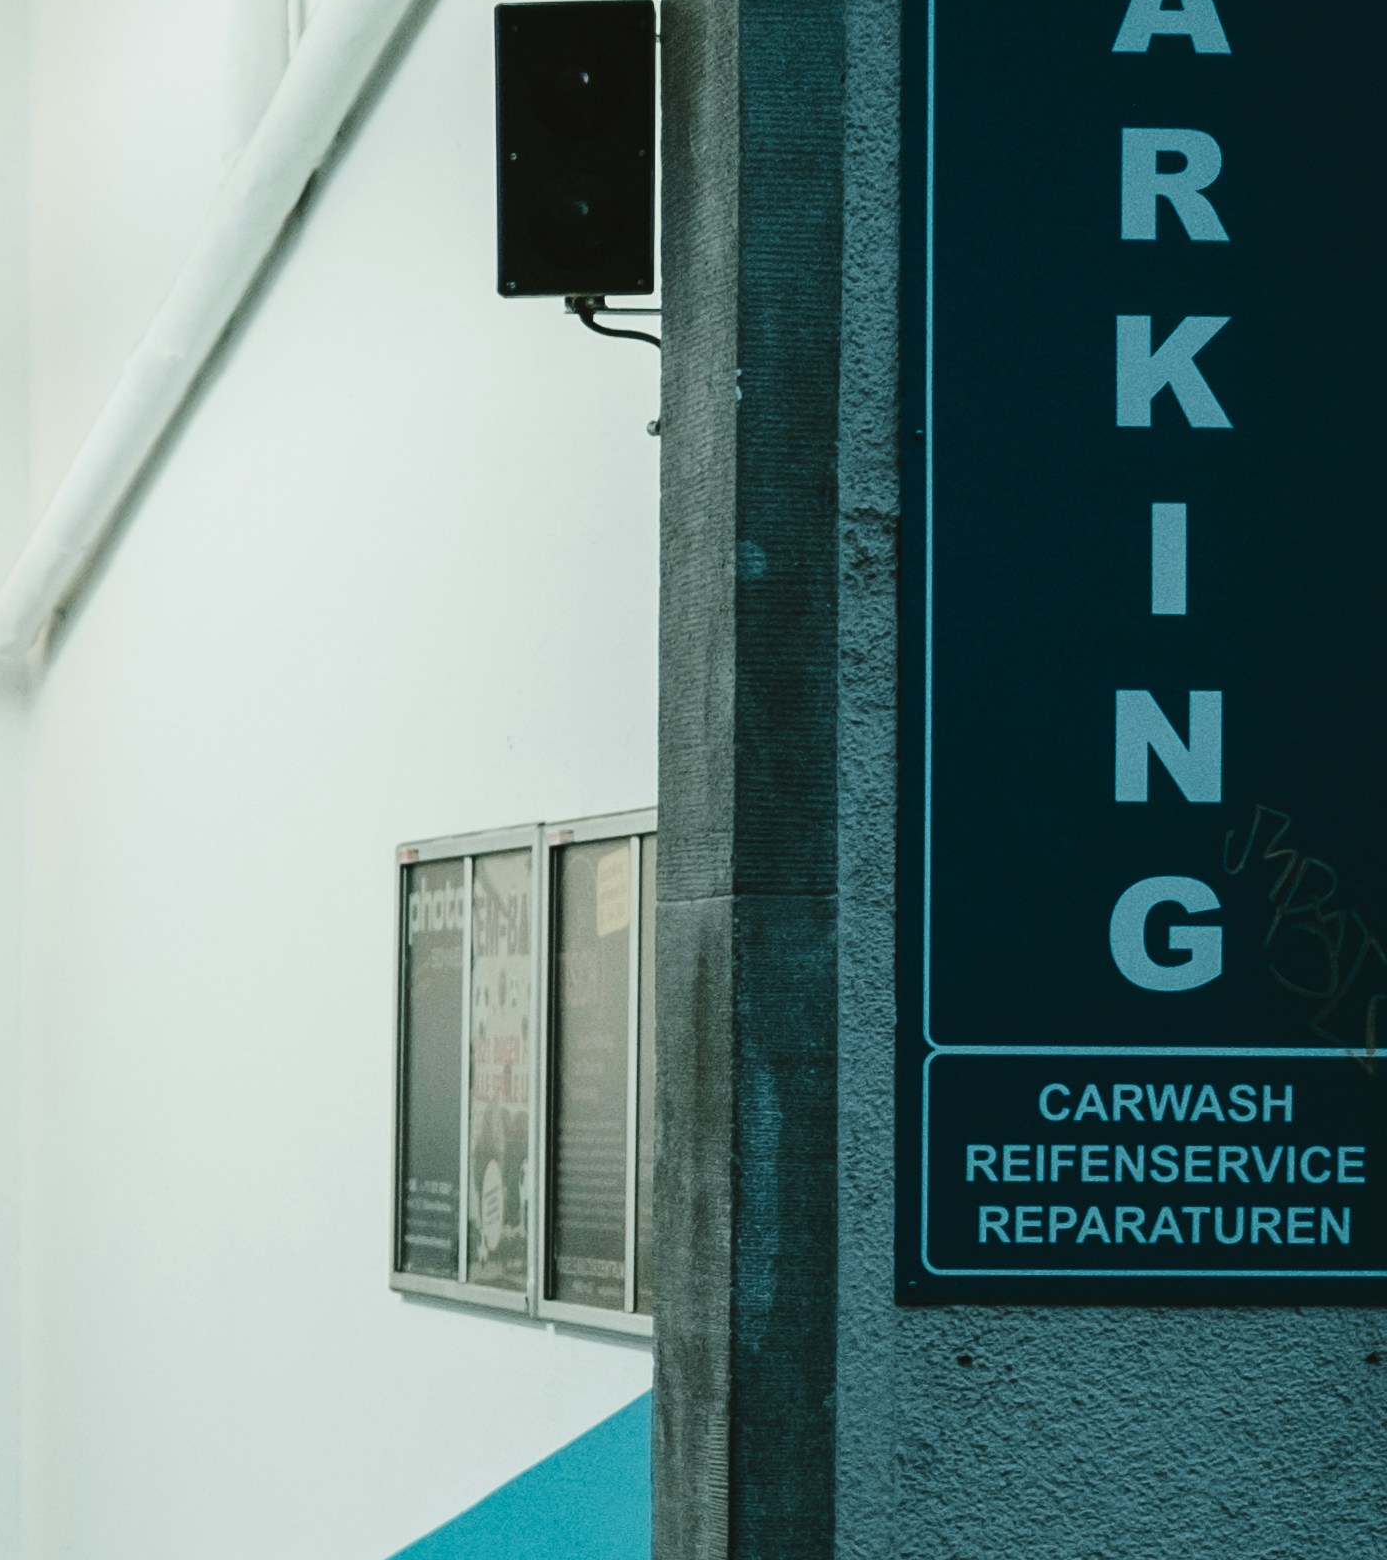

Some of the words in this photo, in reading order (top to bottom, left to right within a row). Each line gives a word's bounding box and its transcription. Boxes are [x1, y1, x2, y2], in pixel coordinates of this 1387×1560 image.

[1038, 1083, 1294, 1123] CARWASH
[966, 1144, 1366, 1185] REIFENSERVICE
[978, 1205, 1351, 1246] REPARATUREN
